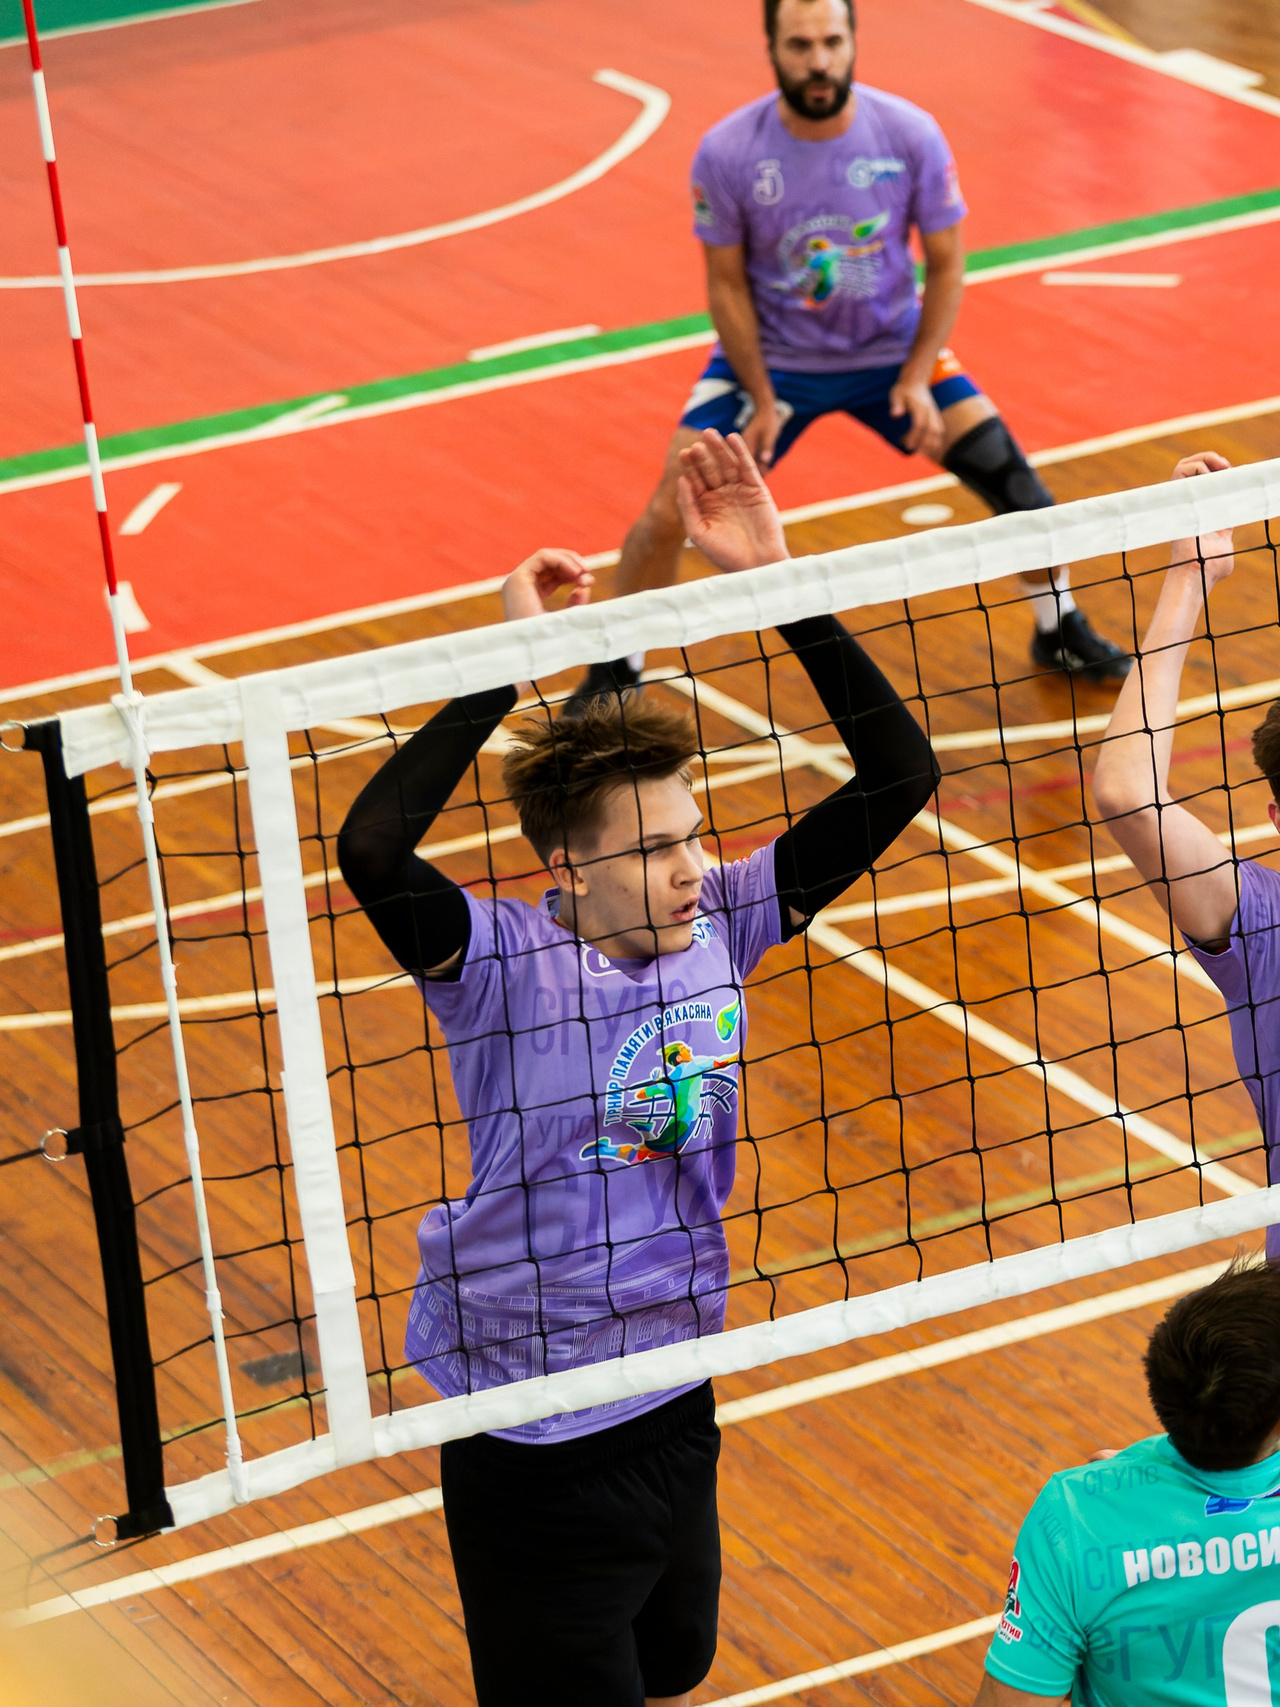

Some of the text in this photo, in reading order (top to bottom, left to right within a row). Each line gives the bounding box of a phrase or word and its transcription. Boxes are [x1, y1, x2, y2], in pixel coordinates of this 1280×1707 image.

[605, 1004, 712, 1126] ТУРНИР ПАМЯТИ В.Я.КАСЯНА
[1083, 1464, 1158, 1496] СГУПС
